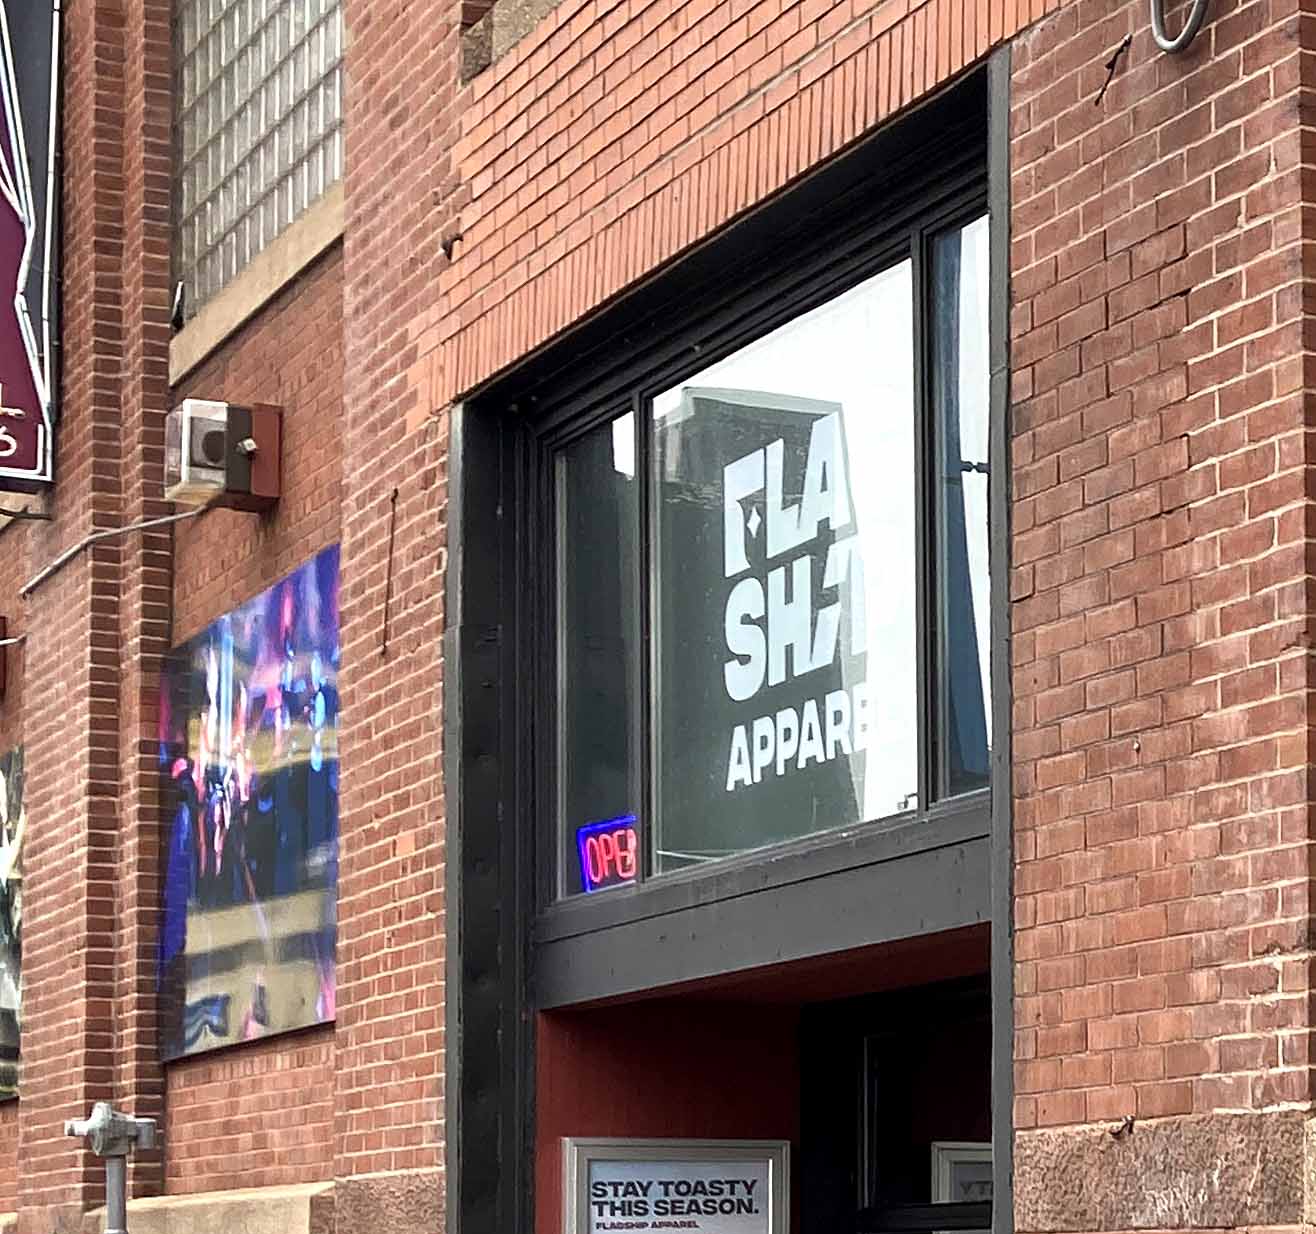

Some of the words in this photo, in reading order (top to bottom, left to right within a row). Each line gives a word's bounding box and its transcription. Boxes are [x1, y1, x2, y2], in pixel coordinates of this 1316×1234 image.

[592, 1180, 653, 1198] STAY
[658, 1179, 757, 1196] TOASTY
[592, 1200, 649, 1217] THIS
[654, 1198, 759, 1216] SEASON.
[595, 1221, 649, 1230] FLAGSHIP
[651, 1220, 700, 1229] APPAREL
